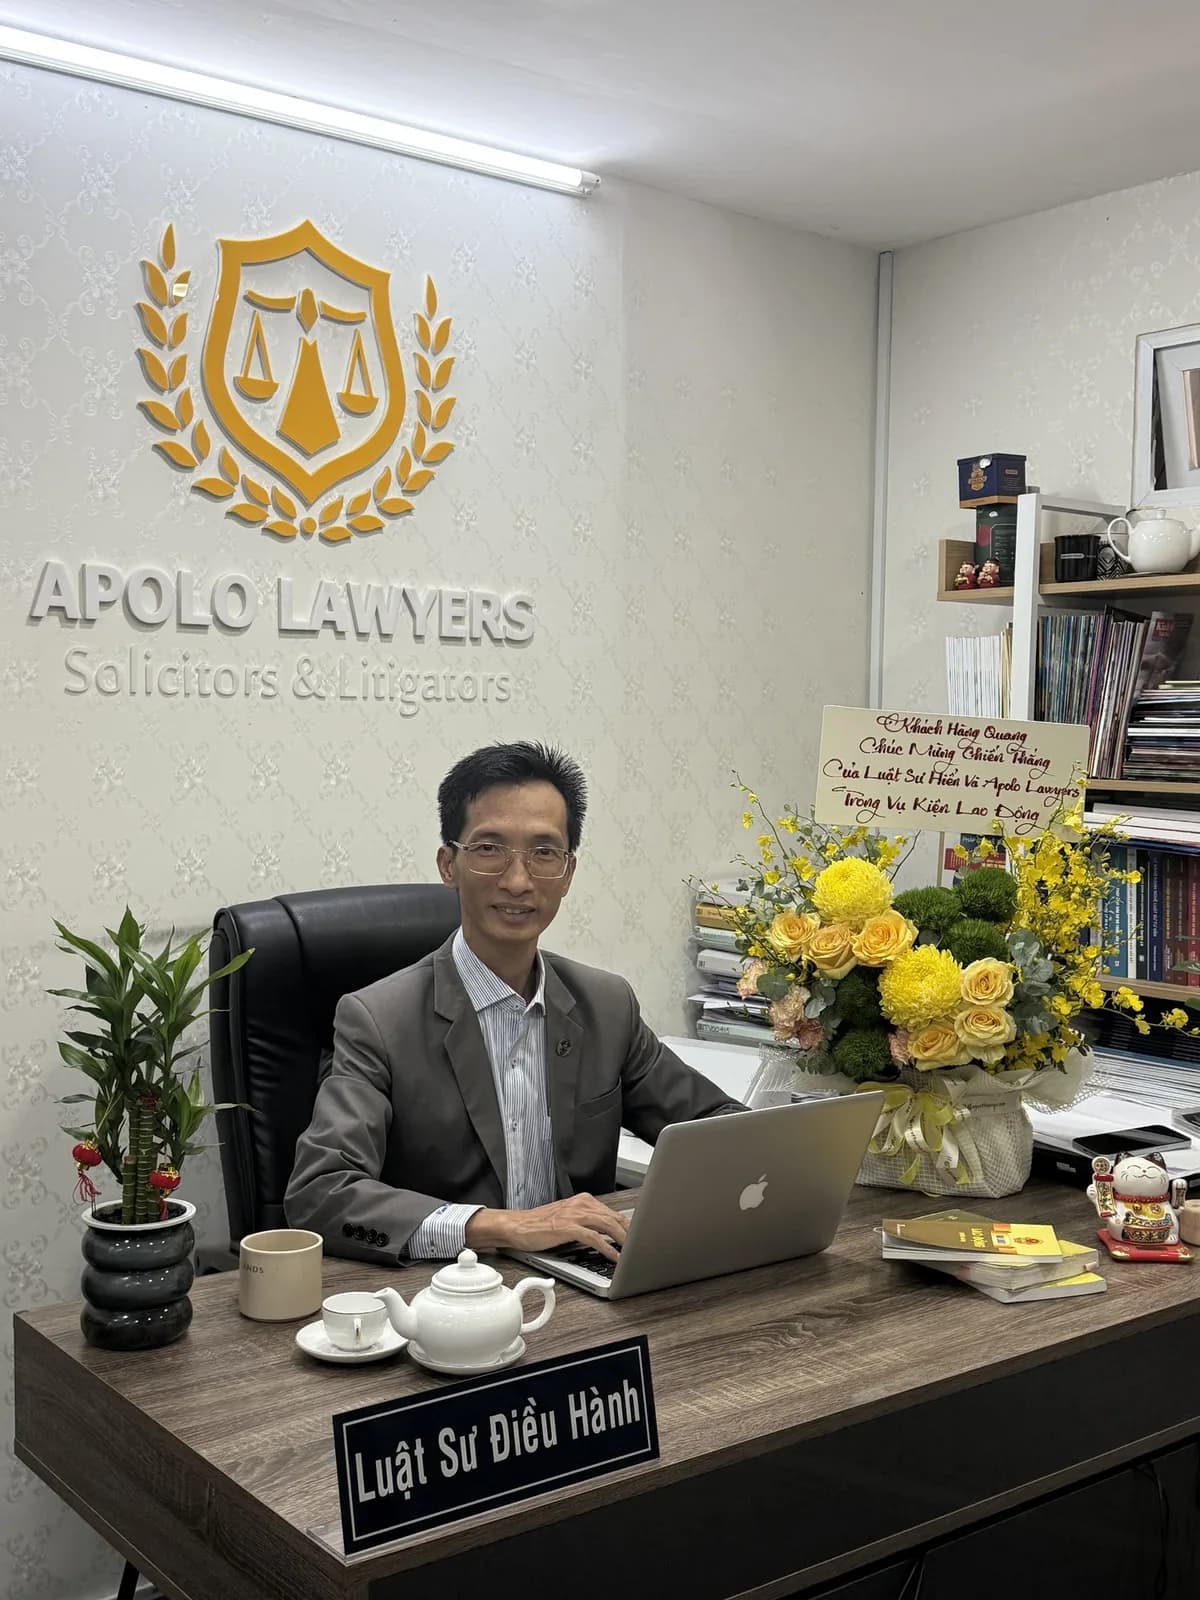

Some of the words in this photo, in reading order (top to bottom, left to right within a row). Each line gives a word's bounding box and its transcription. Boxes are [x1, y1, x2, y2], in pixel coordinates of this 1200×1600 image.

[28, 560, 257, 634] APOLO
[277, 577, 537, 645] LAWYERS
[63, 646, 280, 698] Solicitors
[338, 656, 513, 718] Litigators
[859, 737, 904, 756] Chúc
[908, 742, 958, 774] Mừng
[961, 745, 1004, 763] Chiến
[1009, 748, 1055, 780] Thắng
[876, 713, 943, 735] Khách
[946, 722, 981, 750] Hàng
[983, 725, 1031, 755] Quang
[822, 758, 860, 779] Của
[863, 765, 902, 786] Luật
[904, 768, 927, 784] Sư
[964, 774, 980, 788] Và
[981, 776, 1021, 797] Apolo
[1025, 780, 1080, 808] Lawyers
[831, 786, 887, 825] Trong
[887, 795, 906, 815] Vụ
[912, 797, 951, 818] Kiện
[956, 800, 988, 817] Lao
[993, 804, 1046, 836] Động
[354, 1437, 428, 1503] Luật
[438, 1425, 478, 1479] Sư
[489, 1396, 558, 1464] Điều
[567, 1379, 641, 1440] Hành
